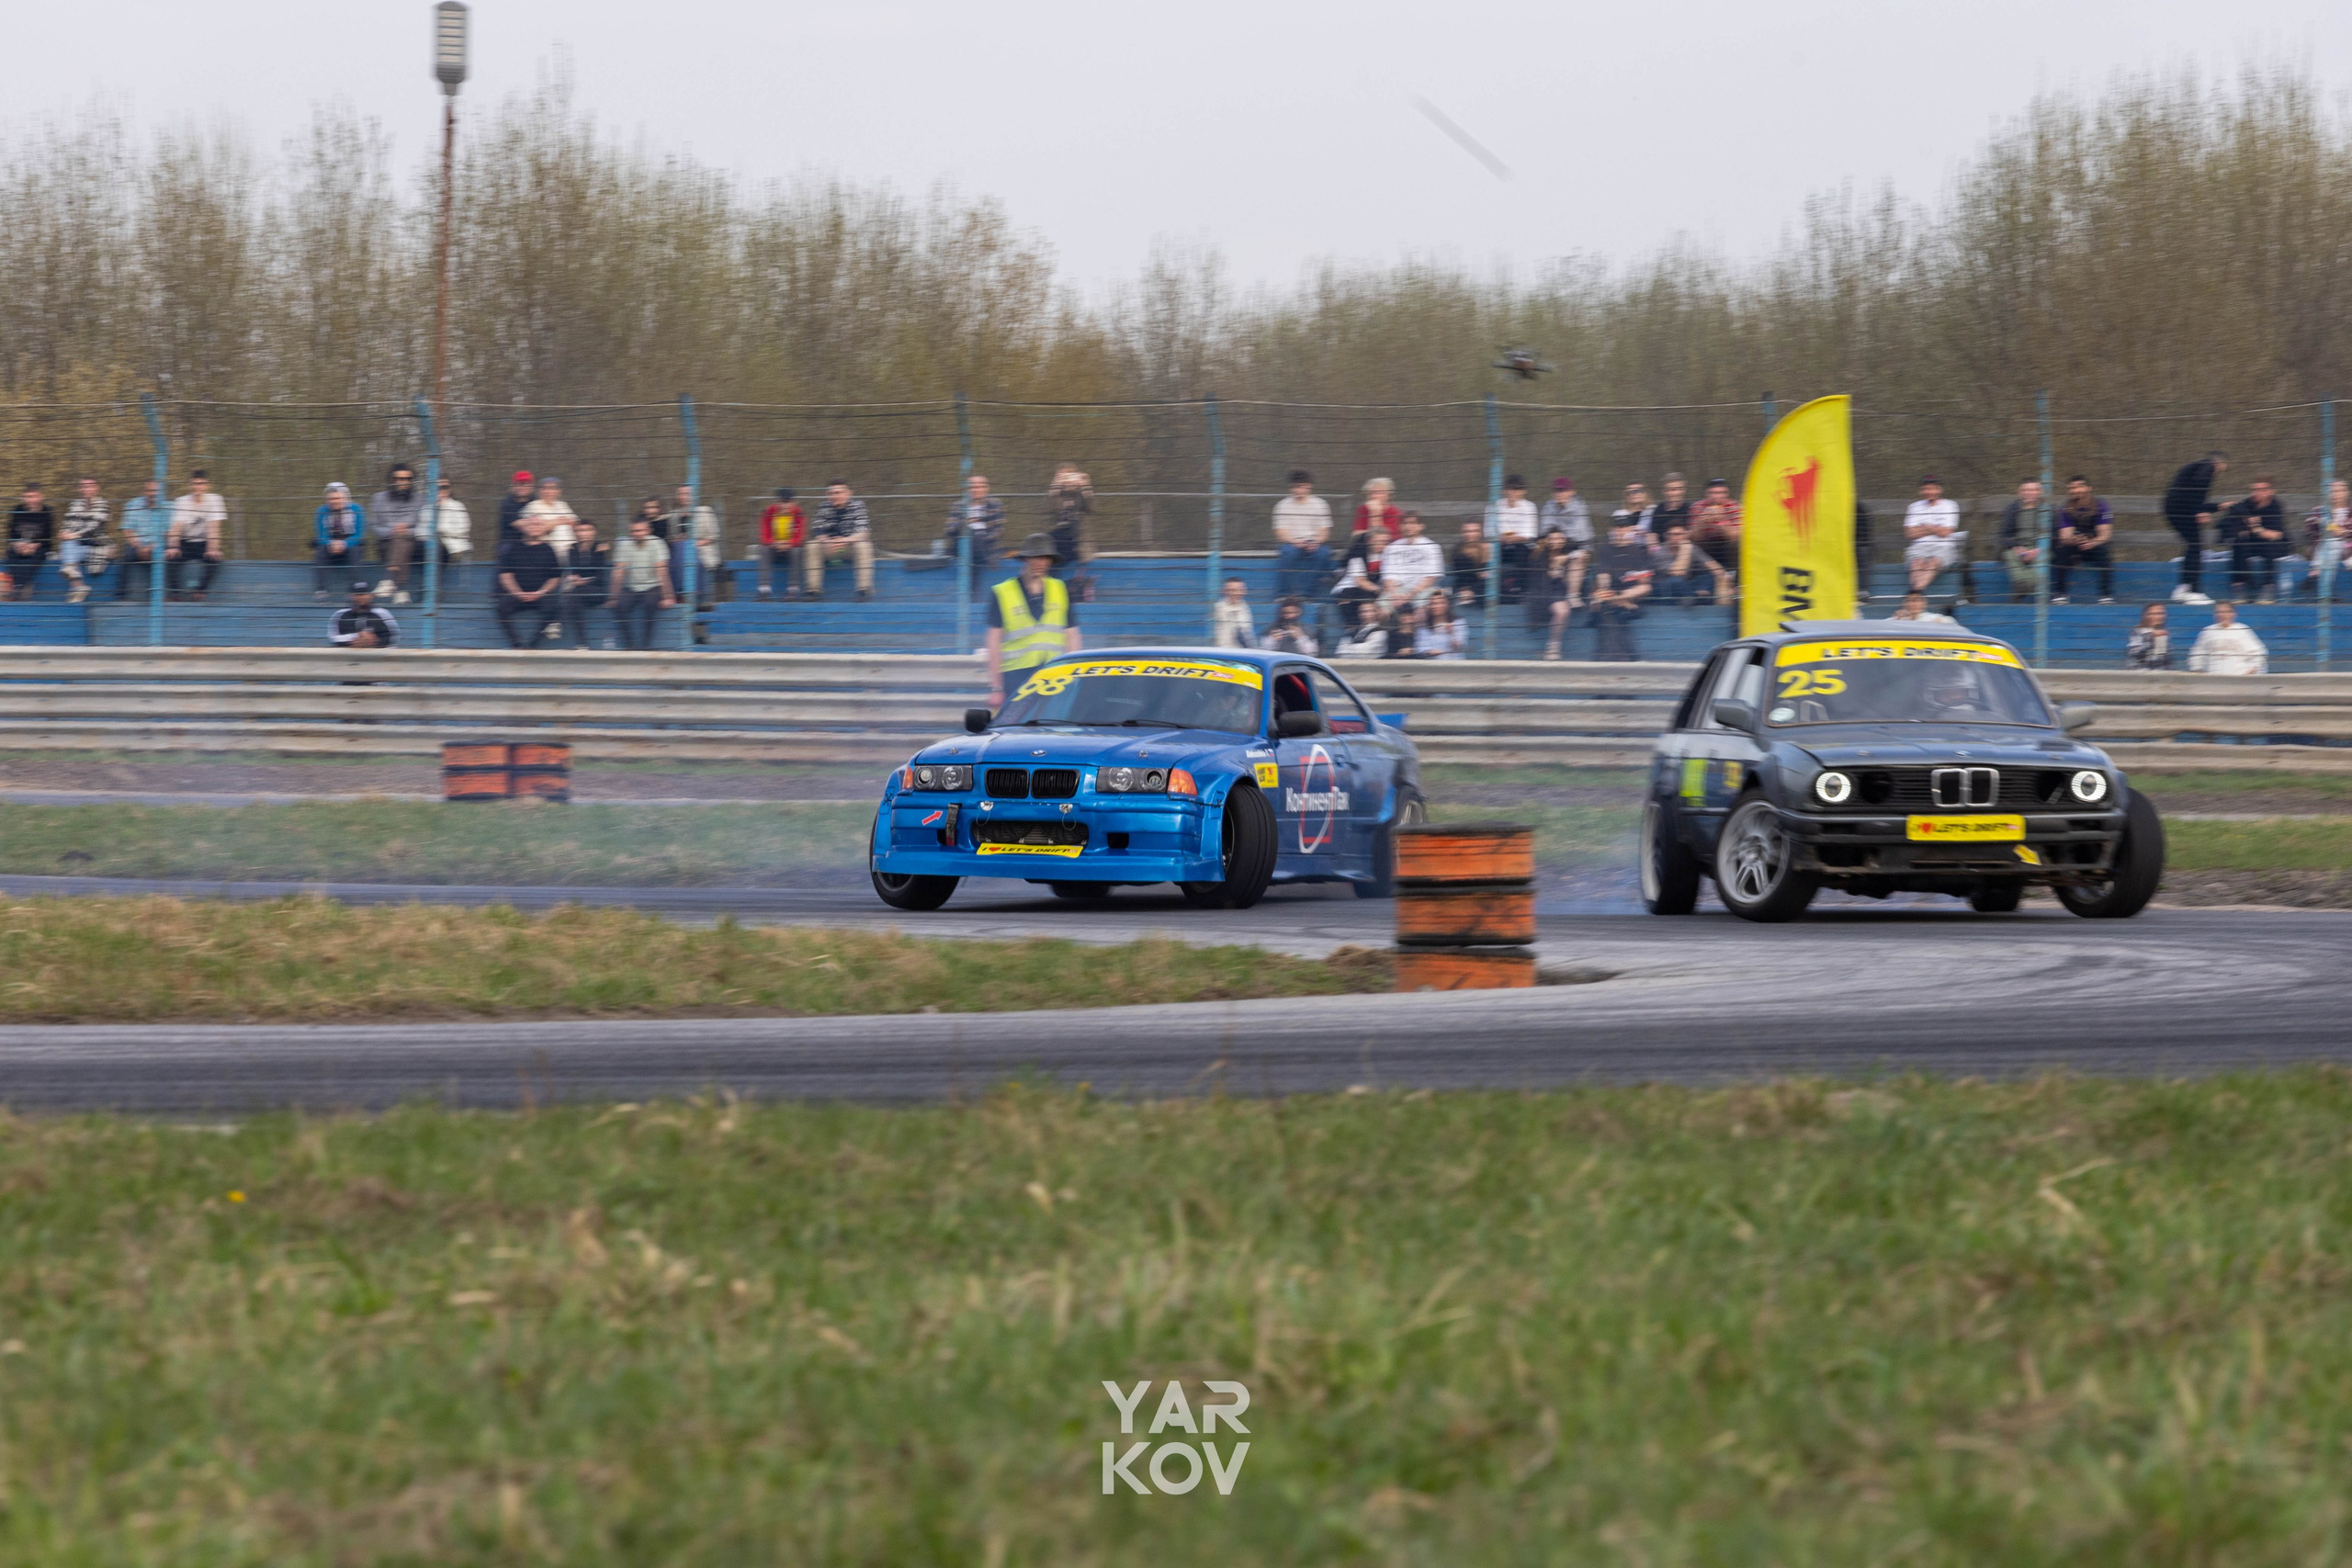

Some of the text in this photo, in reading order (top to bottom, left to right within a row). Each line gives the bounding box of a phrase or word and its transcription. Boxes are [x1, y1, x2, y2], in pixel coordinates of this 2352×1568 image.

[1822, 647, 1893, 659] LET'S
[1903, 647, 1980, 660] DRIFT
[1071, 665, 1137, 677] LET'S
[1141, 665, 1217, 679] DRIFT
[1012, 675, 1074, 702] 98
[1777, 669, 1848, 698] 25
